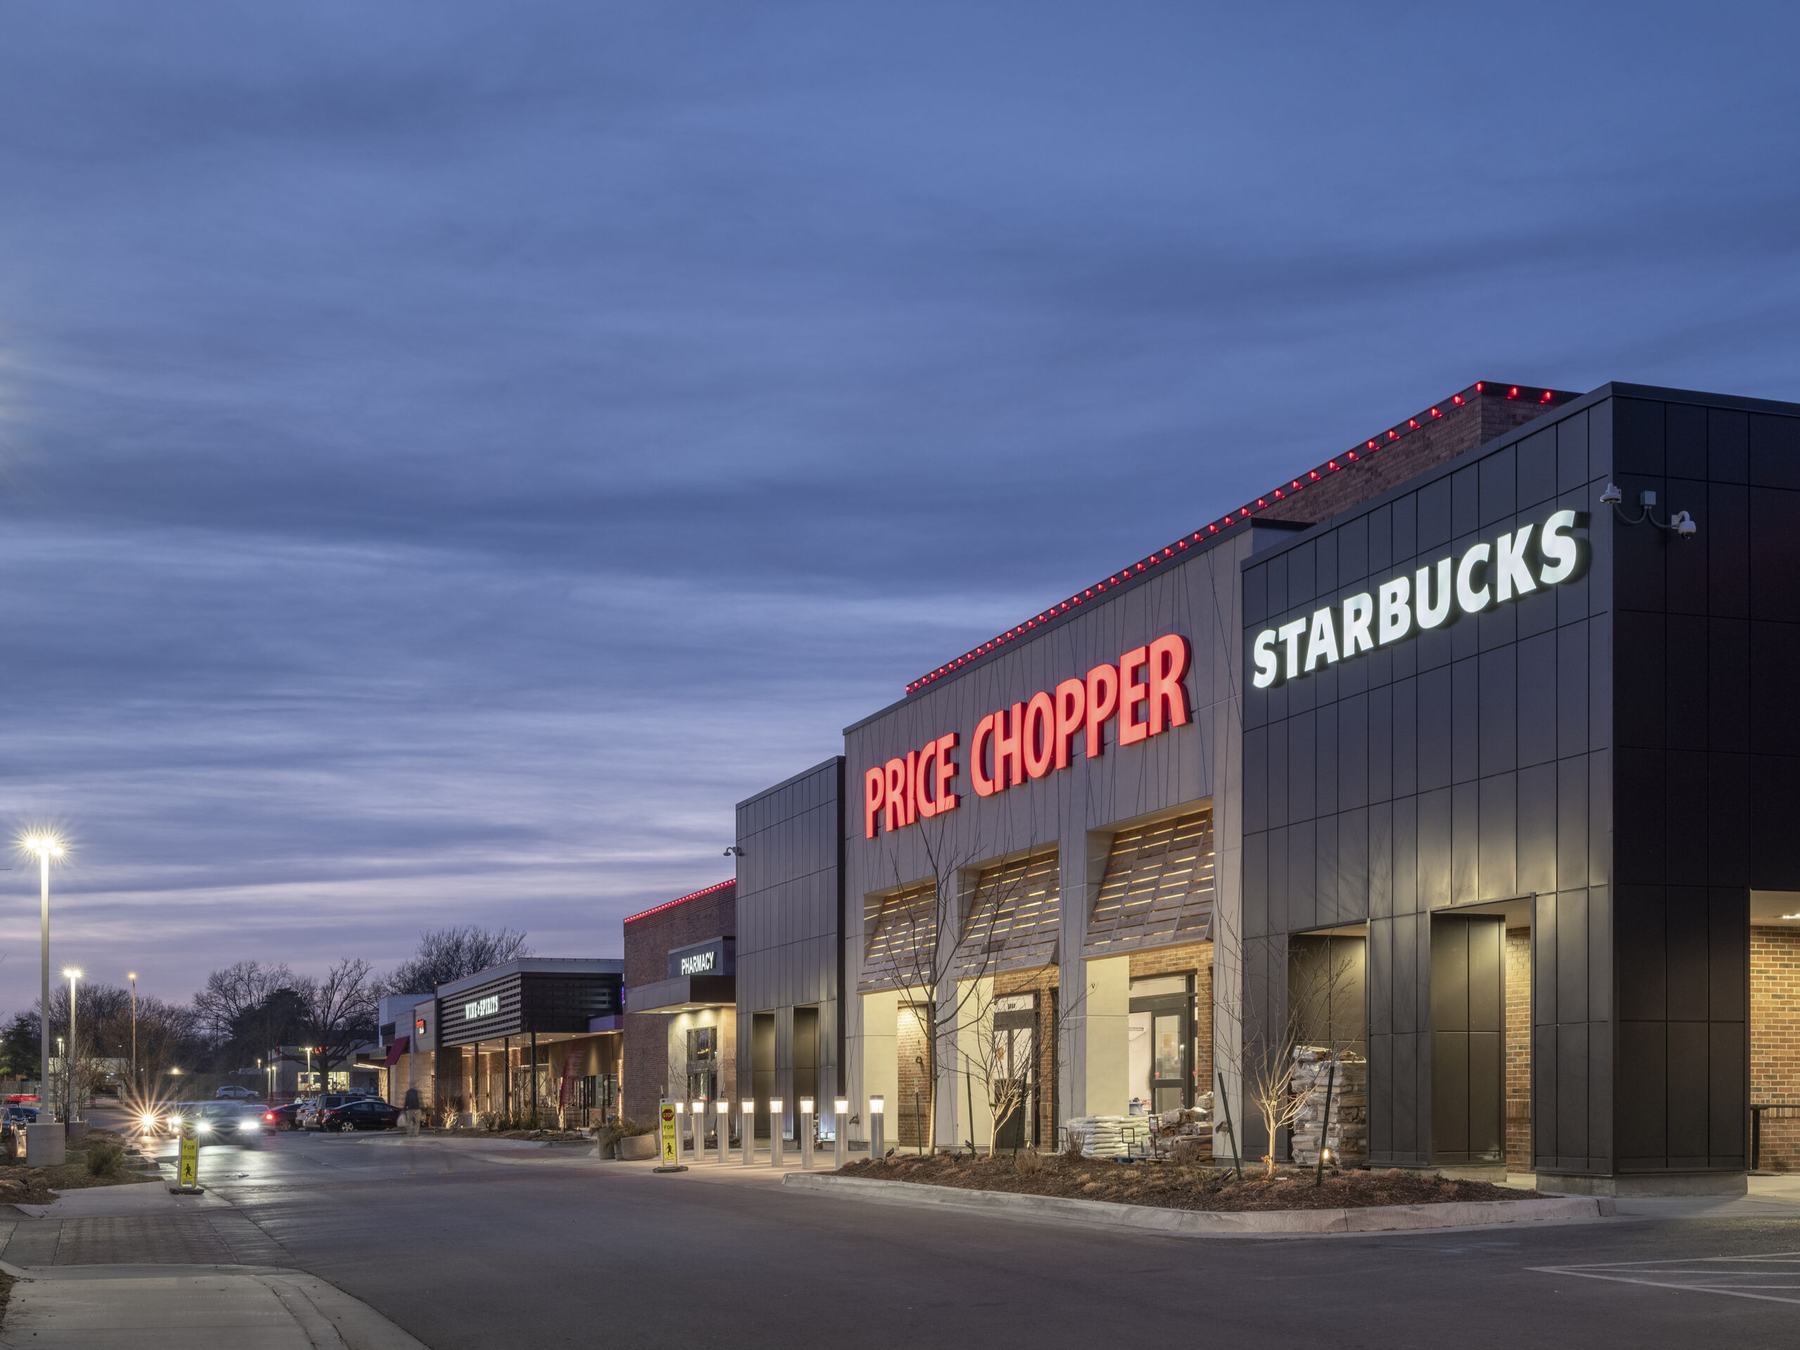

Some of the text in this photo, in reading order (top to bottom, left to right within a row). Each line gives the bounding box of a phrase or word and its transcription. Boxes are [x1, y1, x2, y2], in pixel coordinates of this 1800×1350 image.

[1252, 509, 1578, 689] STARBUCKS
[864, 633, 1191, 839] PRICE CHOPPER
[480, 995, 498, 1017] SPIRITS
[681, 951, 714, 976] PHARMACY
